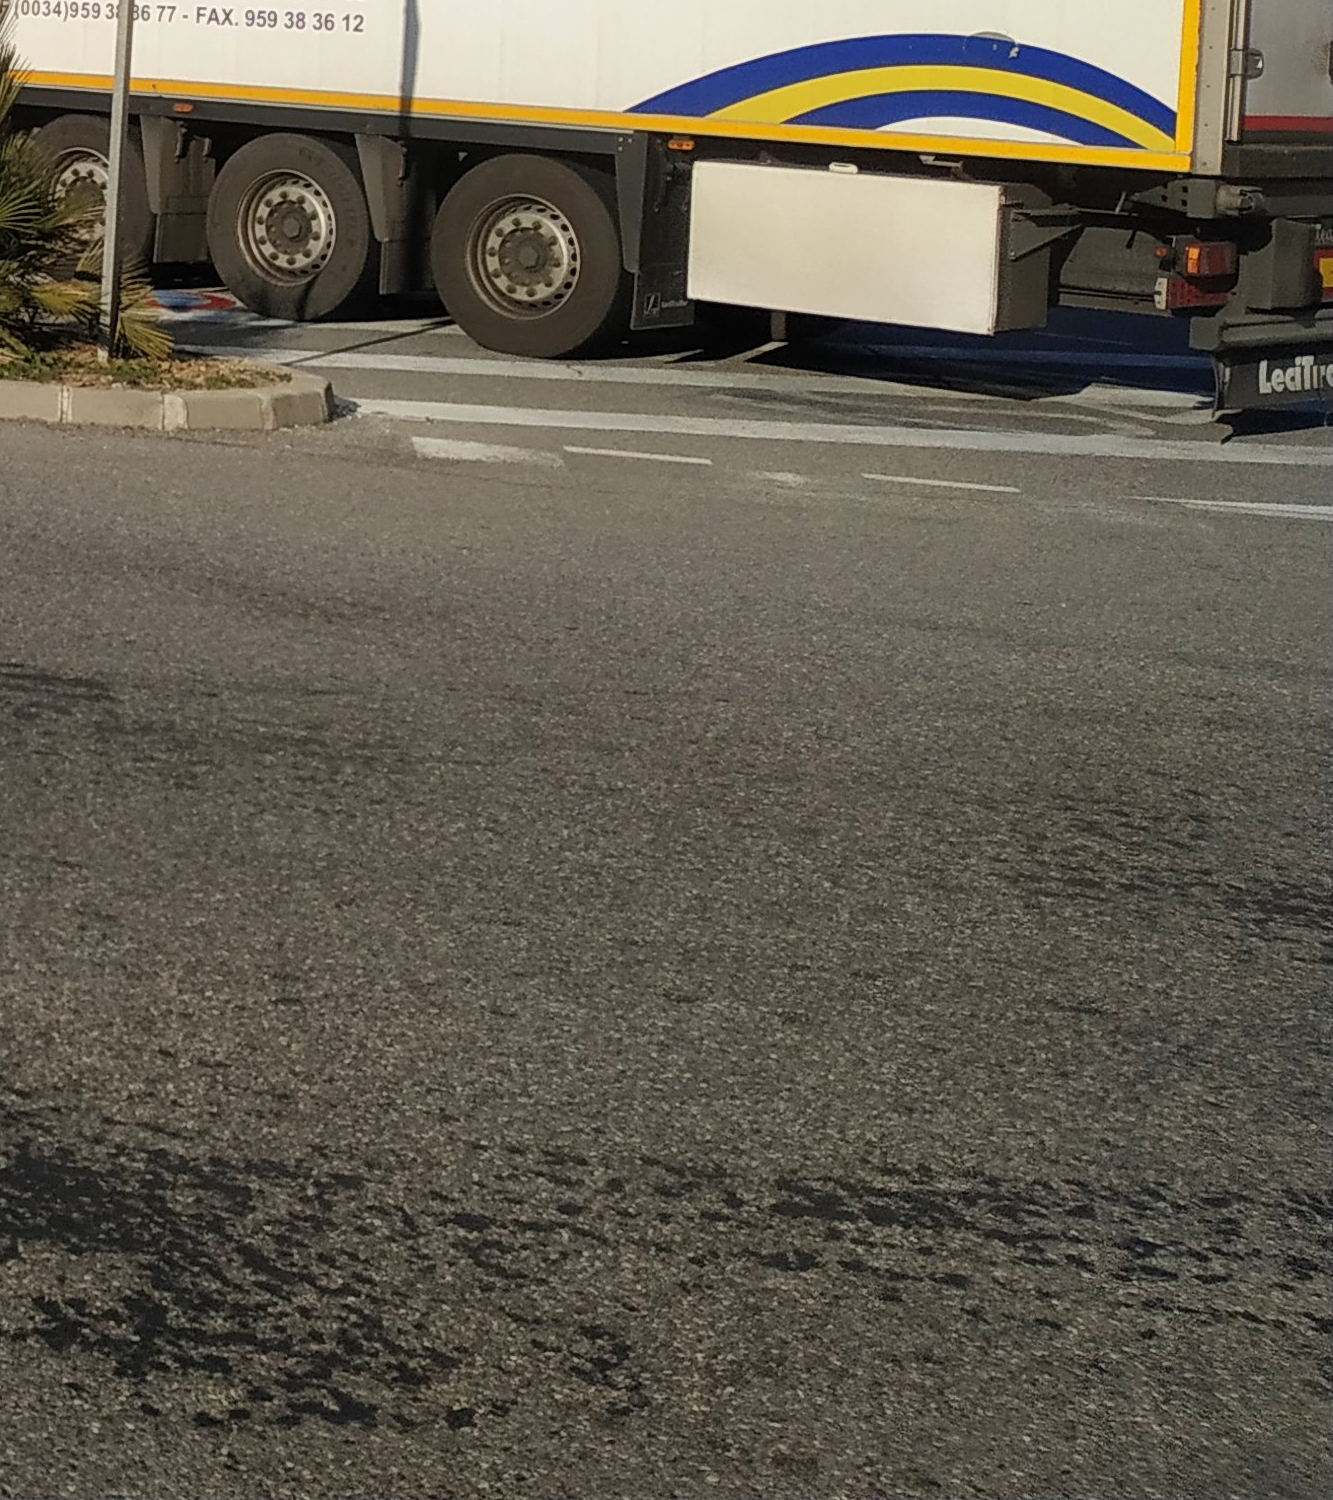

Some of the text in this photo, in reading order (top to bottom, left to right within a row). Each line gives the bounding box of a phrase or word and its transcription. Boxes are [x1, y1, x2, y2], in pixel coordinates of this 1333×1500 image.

[156, 5, 177, 23] 77
[196, 6, 239, 27] FAX.
[244, 9, 278, 29] 959
[283, 11, 307, 30] 38
[312, 12, 336, 32] 36
[341, 14, 365, 33] 12
